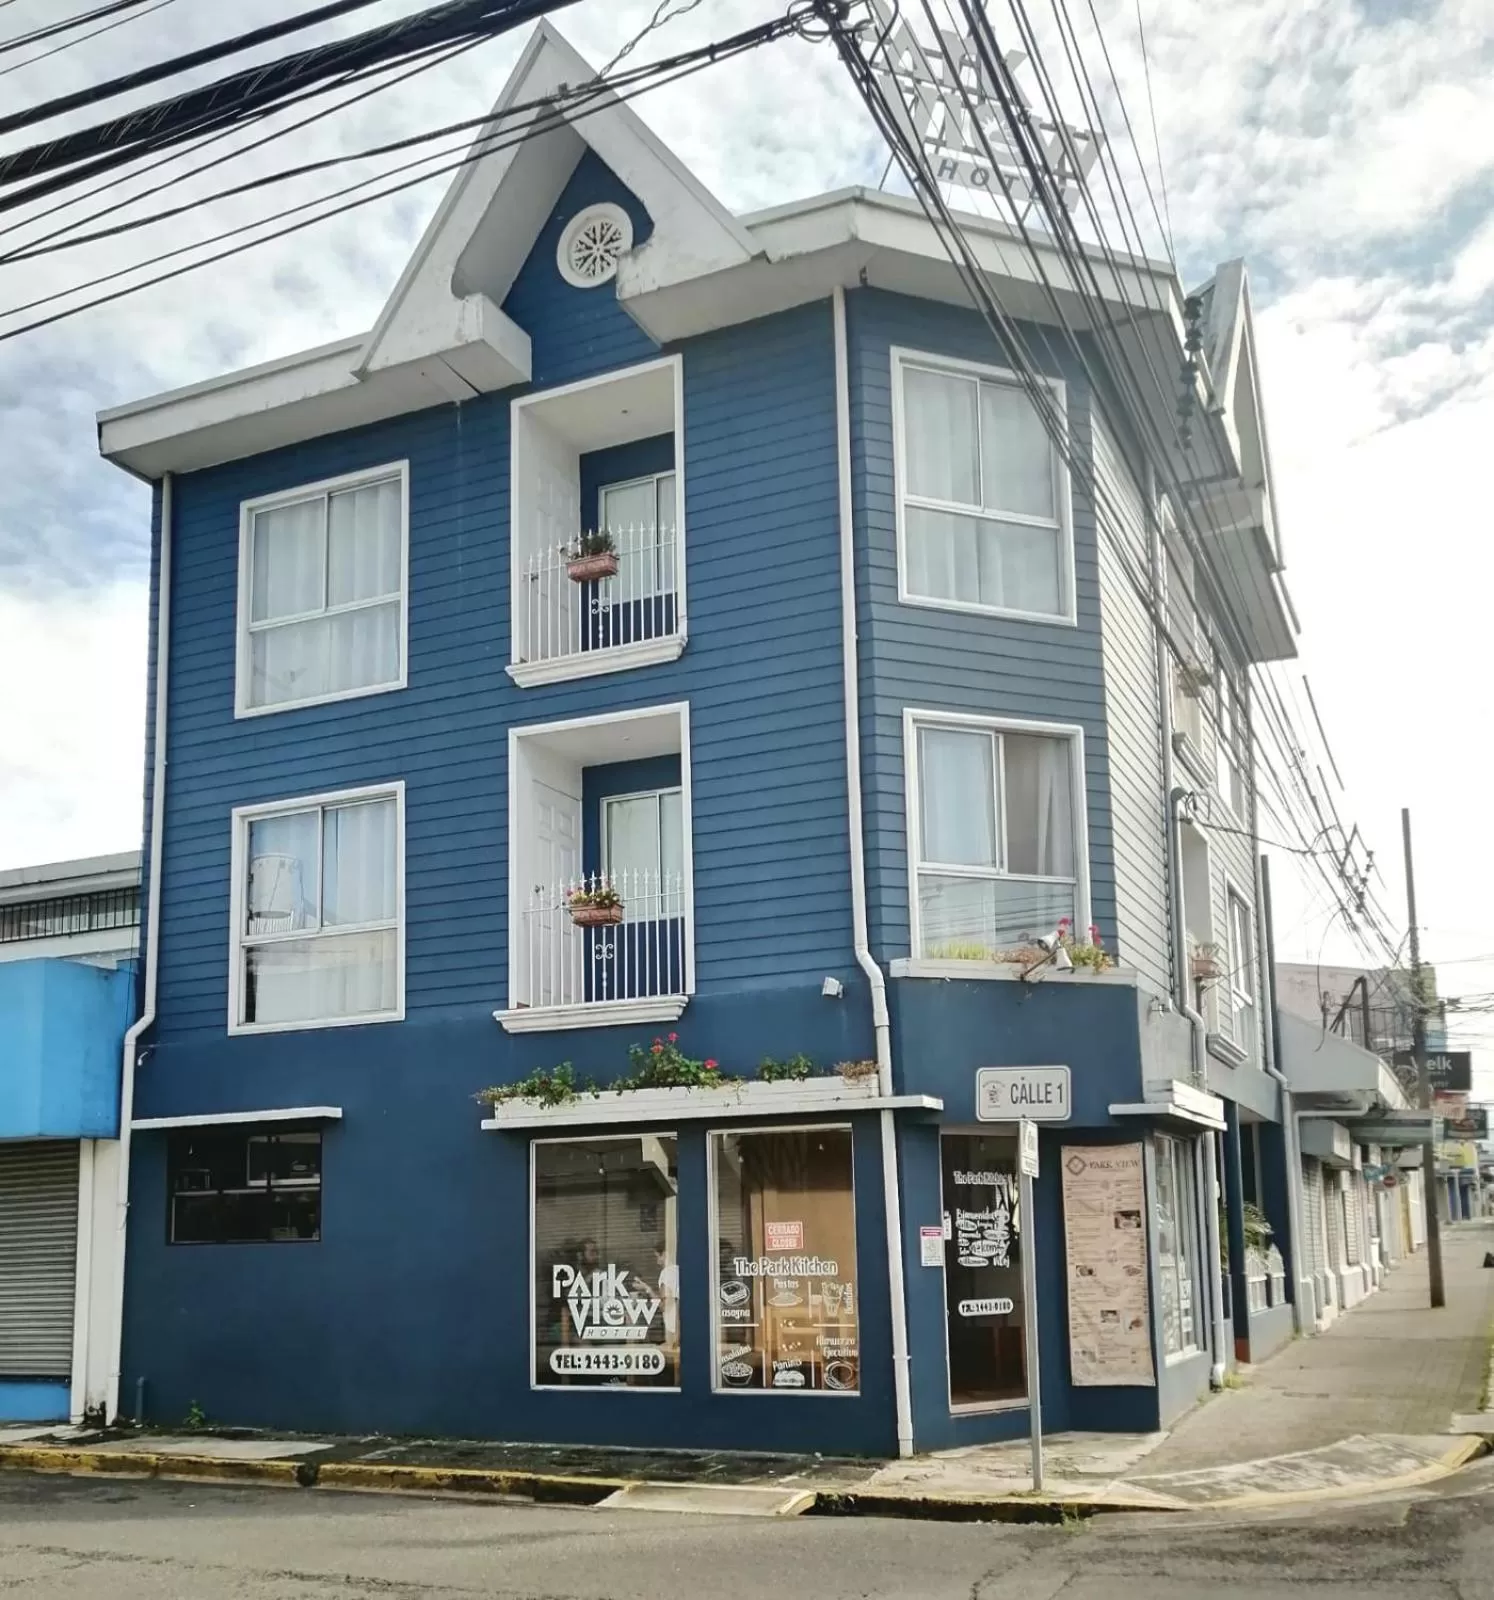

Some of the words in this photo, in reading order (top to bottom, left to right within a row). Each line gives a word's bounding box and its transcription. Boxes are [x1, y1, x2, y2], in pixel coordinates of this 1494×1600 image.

[1010, 1082, 1052, 1104] CALLE
[1057, 1083, 1063, 1104] 1
[734, 1257, 758, 1276] The
[759, 1257, 790, 1275] Park
[790, 1256, 838, 1275] Kitchen
[586, 1329, 642, 1338] HOTEL
[555, 1354, 581, 1369] TEL:
[585, 1354, 660, 1369] 2443-9180
